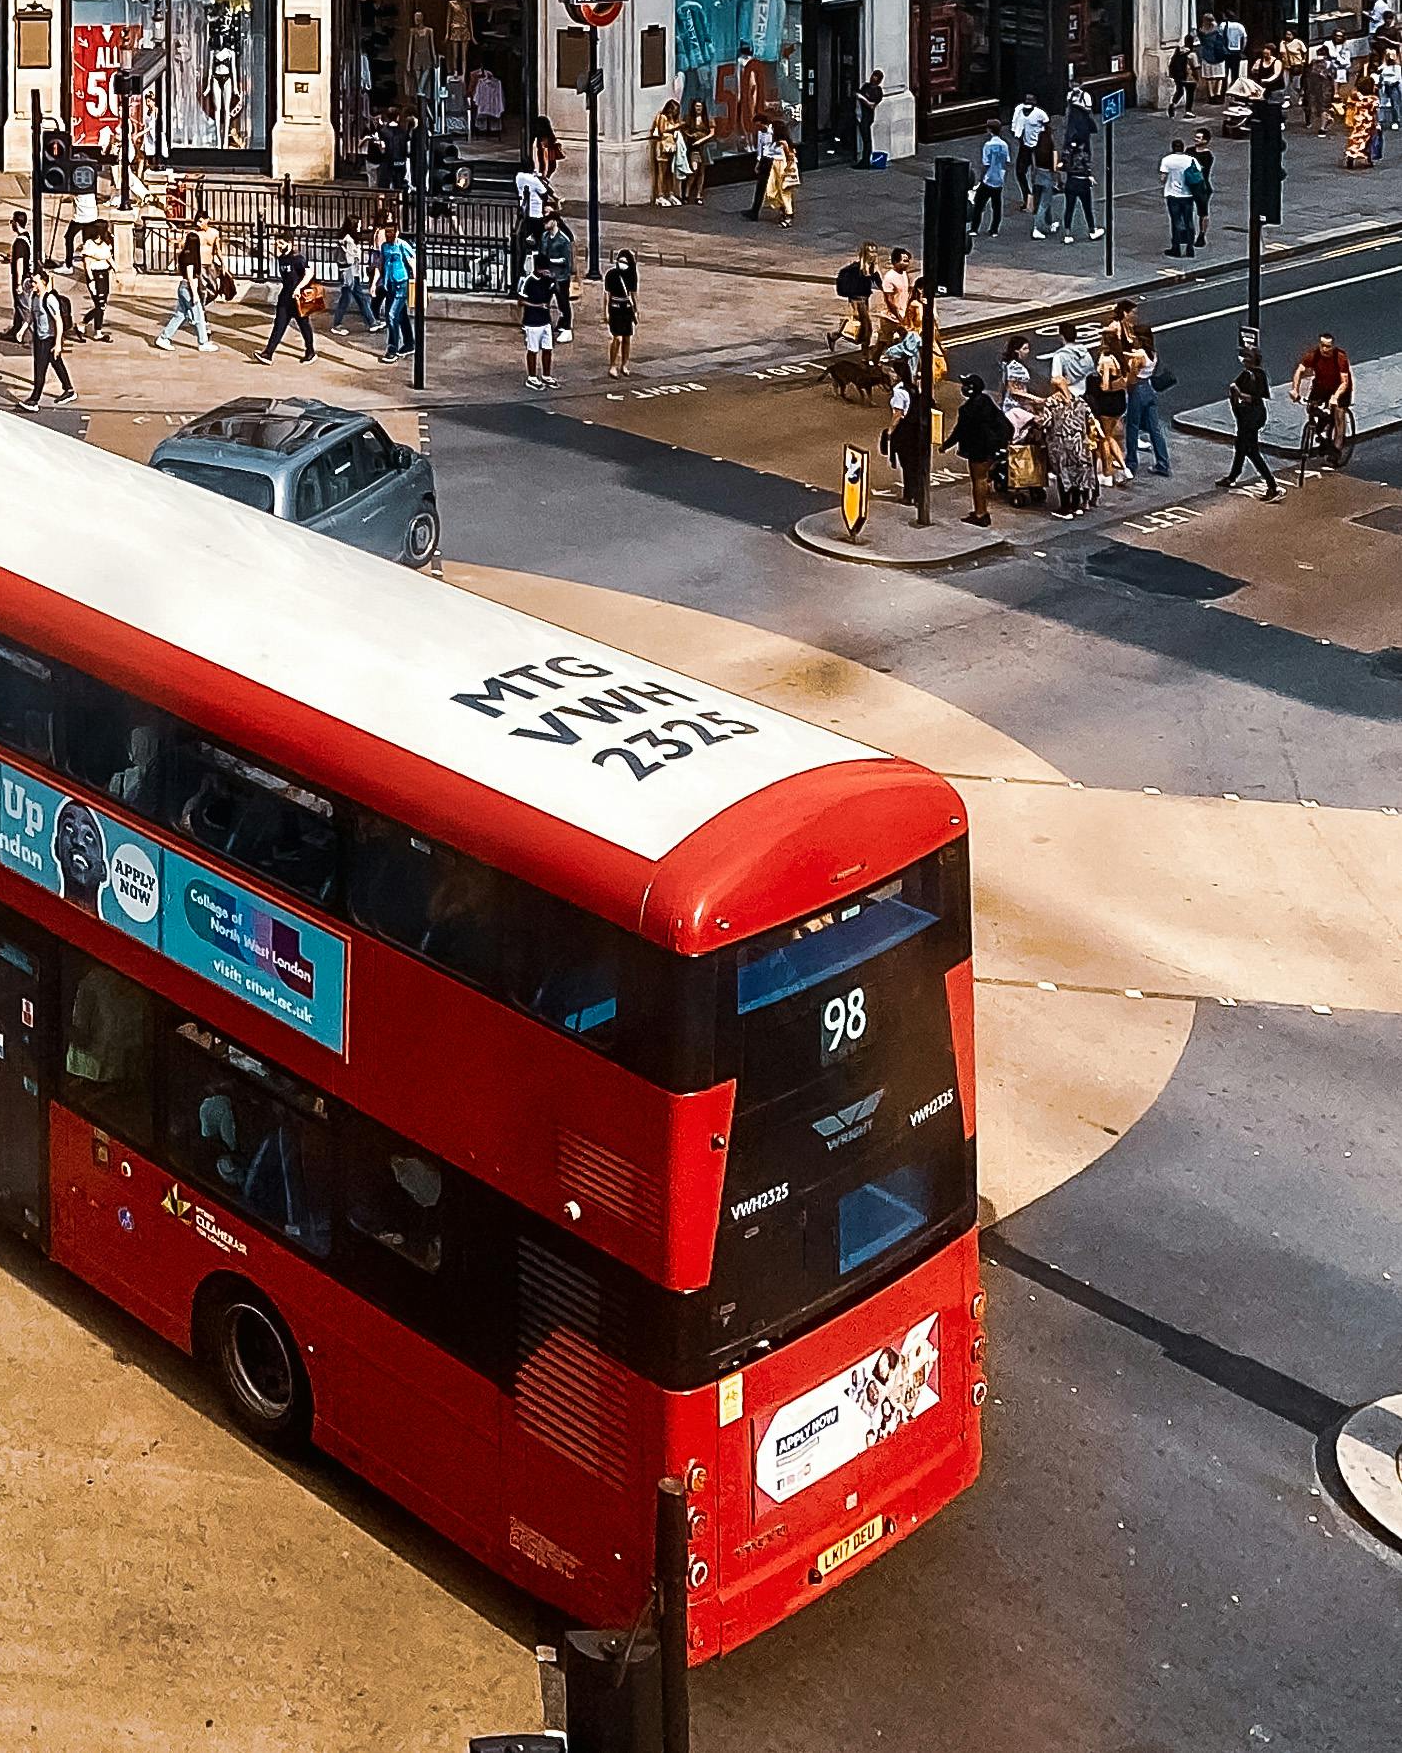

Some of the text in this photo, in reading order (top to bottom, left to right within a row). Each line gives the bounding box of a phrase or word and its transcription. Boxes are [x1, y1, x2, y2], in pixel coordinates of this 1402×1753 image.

[96, 46, 121, 69] ALL
[1123, 506, 1203, 535] LEFT
[449, 656, 614, 718] MTG
[508, 681, 700, 745] VWH
[592, 711, 760, 782] 2325
[2, 777, 45, 837] Up
[114, 858, 156, 891] APPLY
[119, 877, 152, 907] NOW
[190, 888, 244, 926] College of
[210, 918, 312, 984] North West London
[824, 987, 867, 1052] 98
[909, 1088, 954, 1129] VWH2325
[826, 1118, 874, 1152] WRIGHT
[730, 1182, 790, 1221] VWH2325
[777, 1409, 838, 1455] APPLY NOW
[824, 1522, 876, 1569] LK17 DEU
